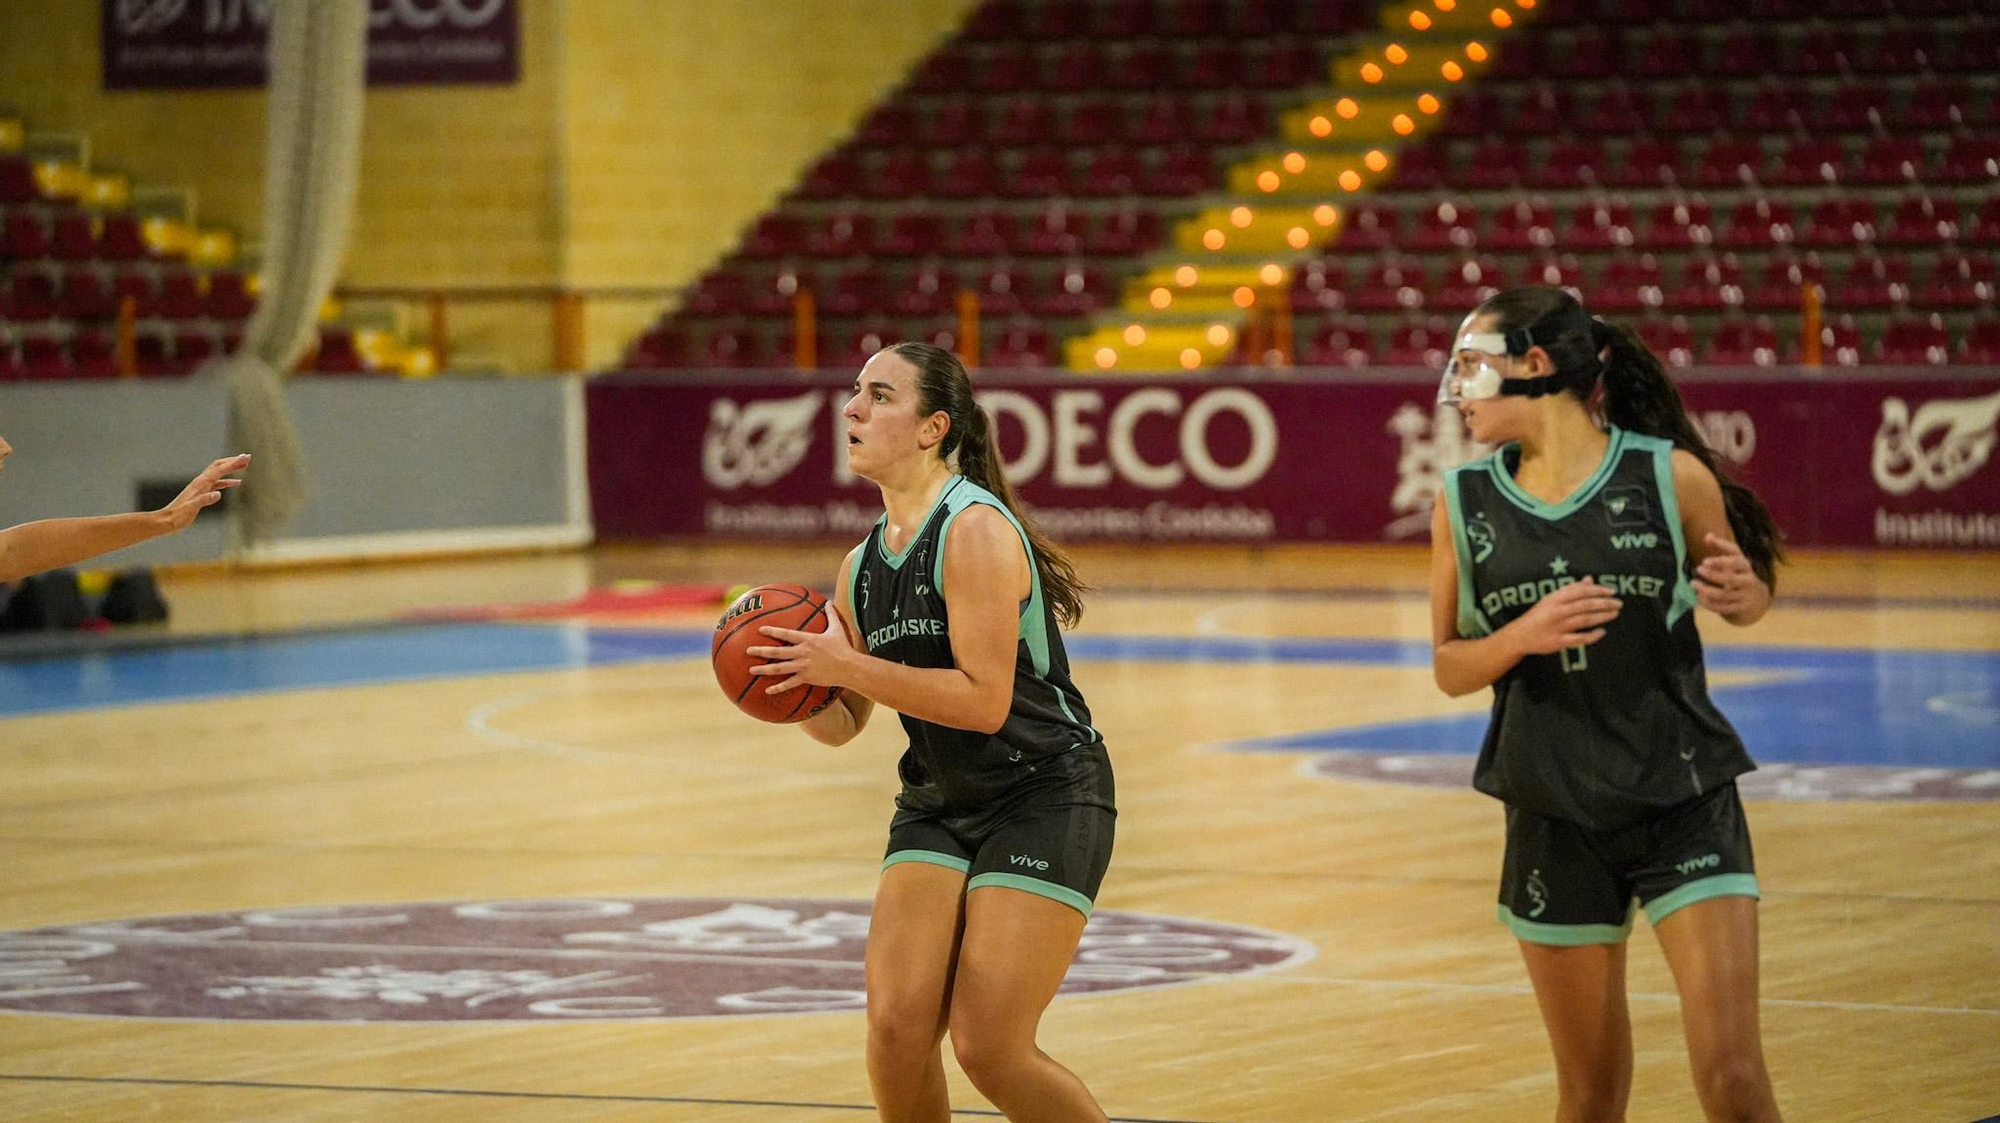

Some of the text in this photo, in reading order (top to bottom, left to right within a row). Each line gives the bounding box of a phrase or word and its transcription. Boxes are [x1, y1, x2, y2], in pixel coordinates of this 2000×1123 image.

[833, 387, 1279, 490] IDECO
[1610, 532, 1658, 550] vive
[1009, 854, 1050, 871] vive
[1675, 853, 1721, 875] vive
